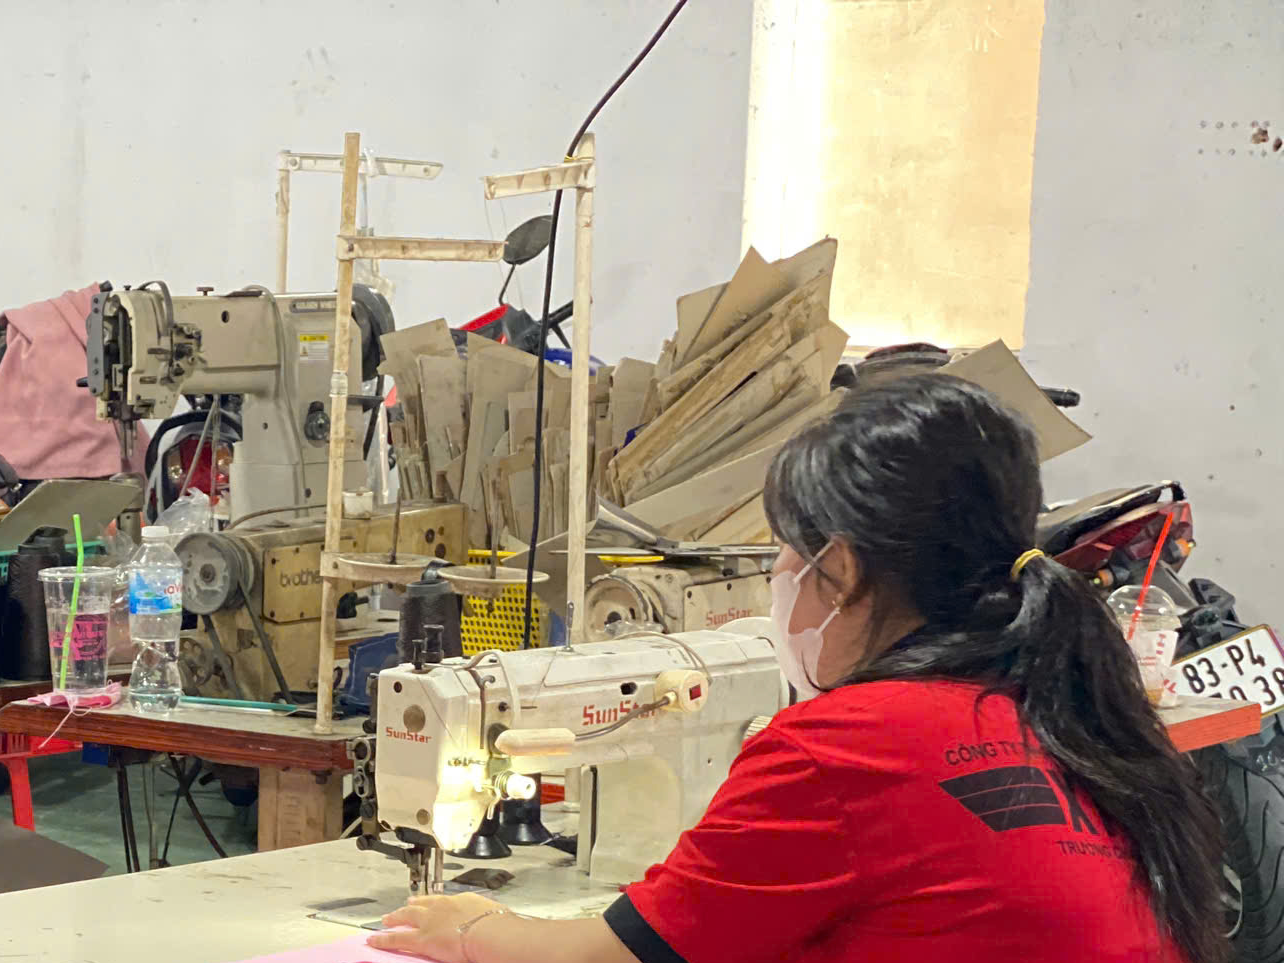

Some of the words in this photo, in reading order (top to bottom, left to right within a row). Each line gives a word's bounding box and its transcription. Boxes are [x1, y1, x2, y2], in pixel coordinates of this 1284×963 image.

[1182, 638, 1266, 694] 83-P4
[385, 726, 432, 744] SunStar
[945, 741, 997, 766] CÔNG
